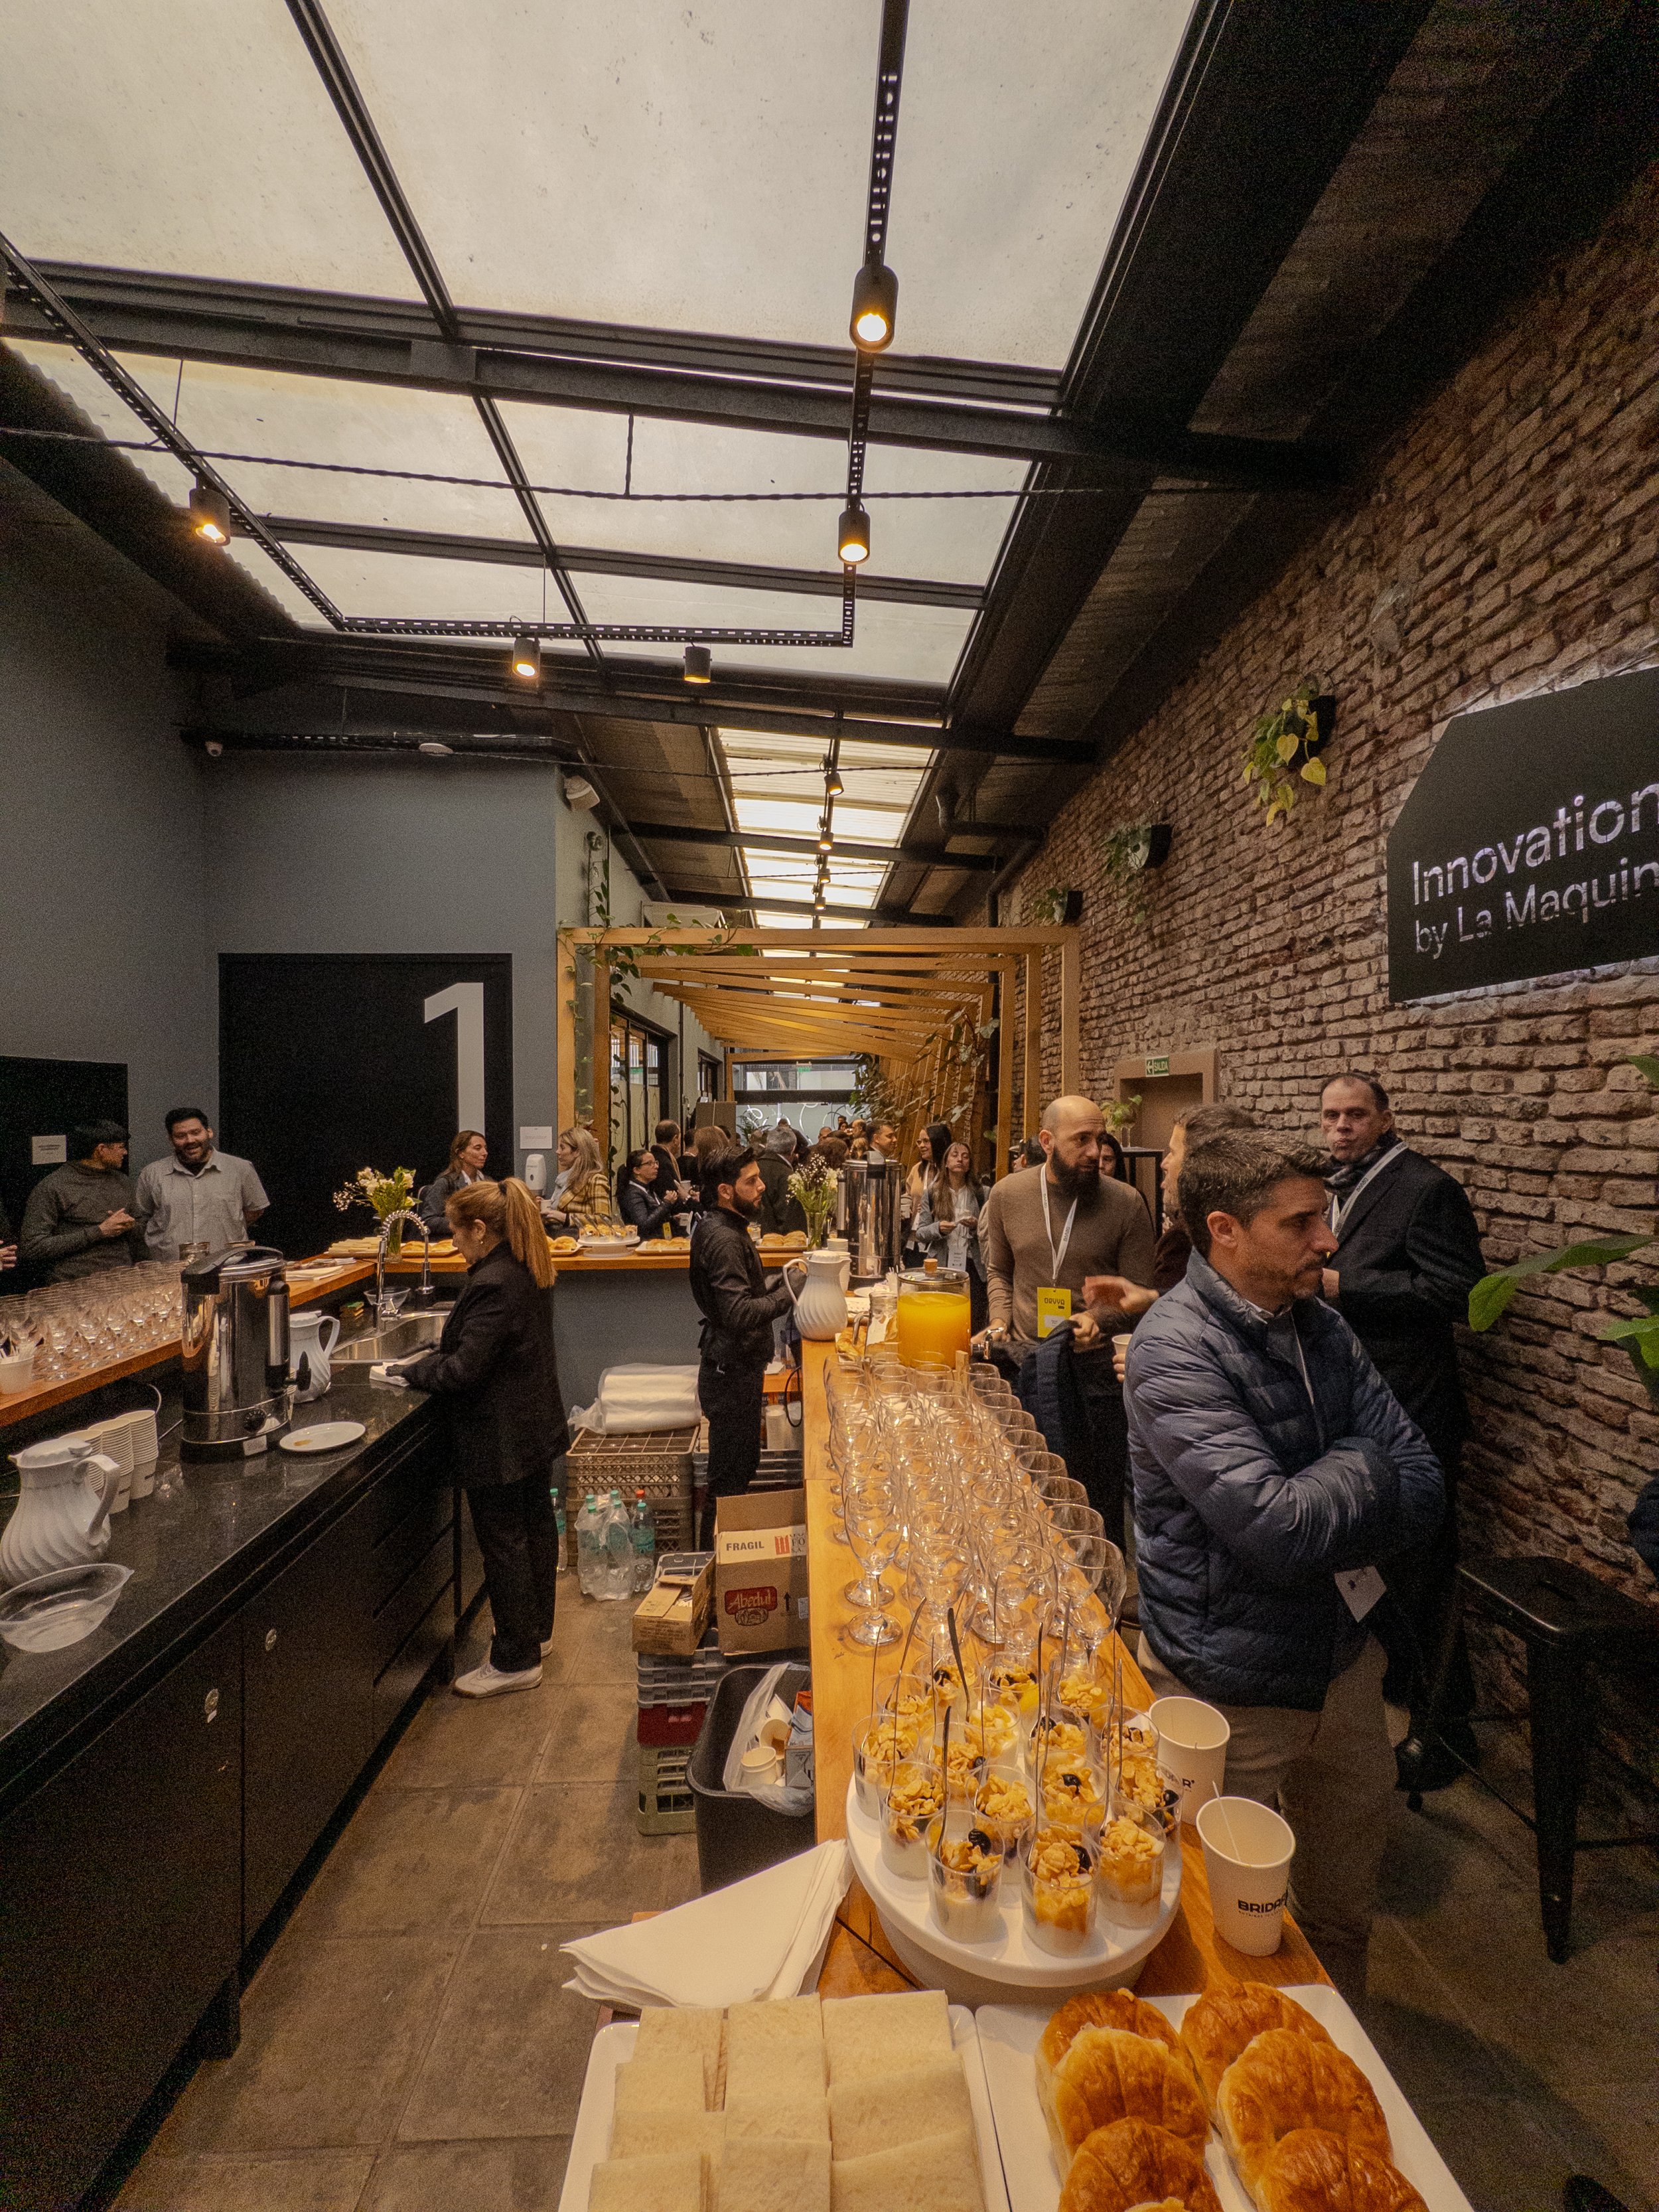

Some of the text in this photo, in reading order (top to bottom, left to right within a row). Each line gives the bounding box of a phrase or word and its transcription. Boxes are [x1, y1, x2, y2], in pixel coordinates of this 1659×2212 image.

[1413, 783, 1659, 906] Innovation
[1415, 857, 1659, 960] by La Maquin
[424, 982, 485, 1138] 1
[726, 1540, 764, 1551] FRAGIL
[728, 1589, 772, 1609] Abedul
